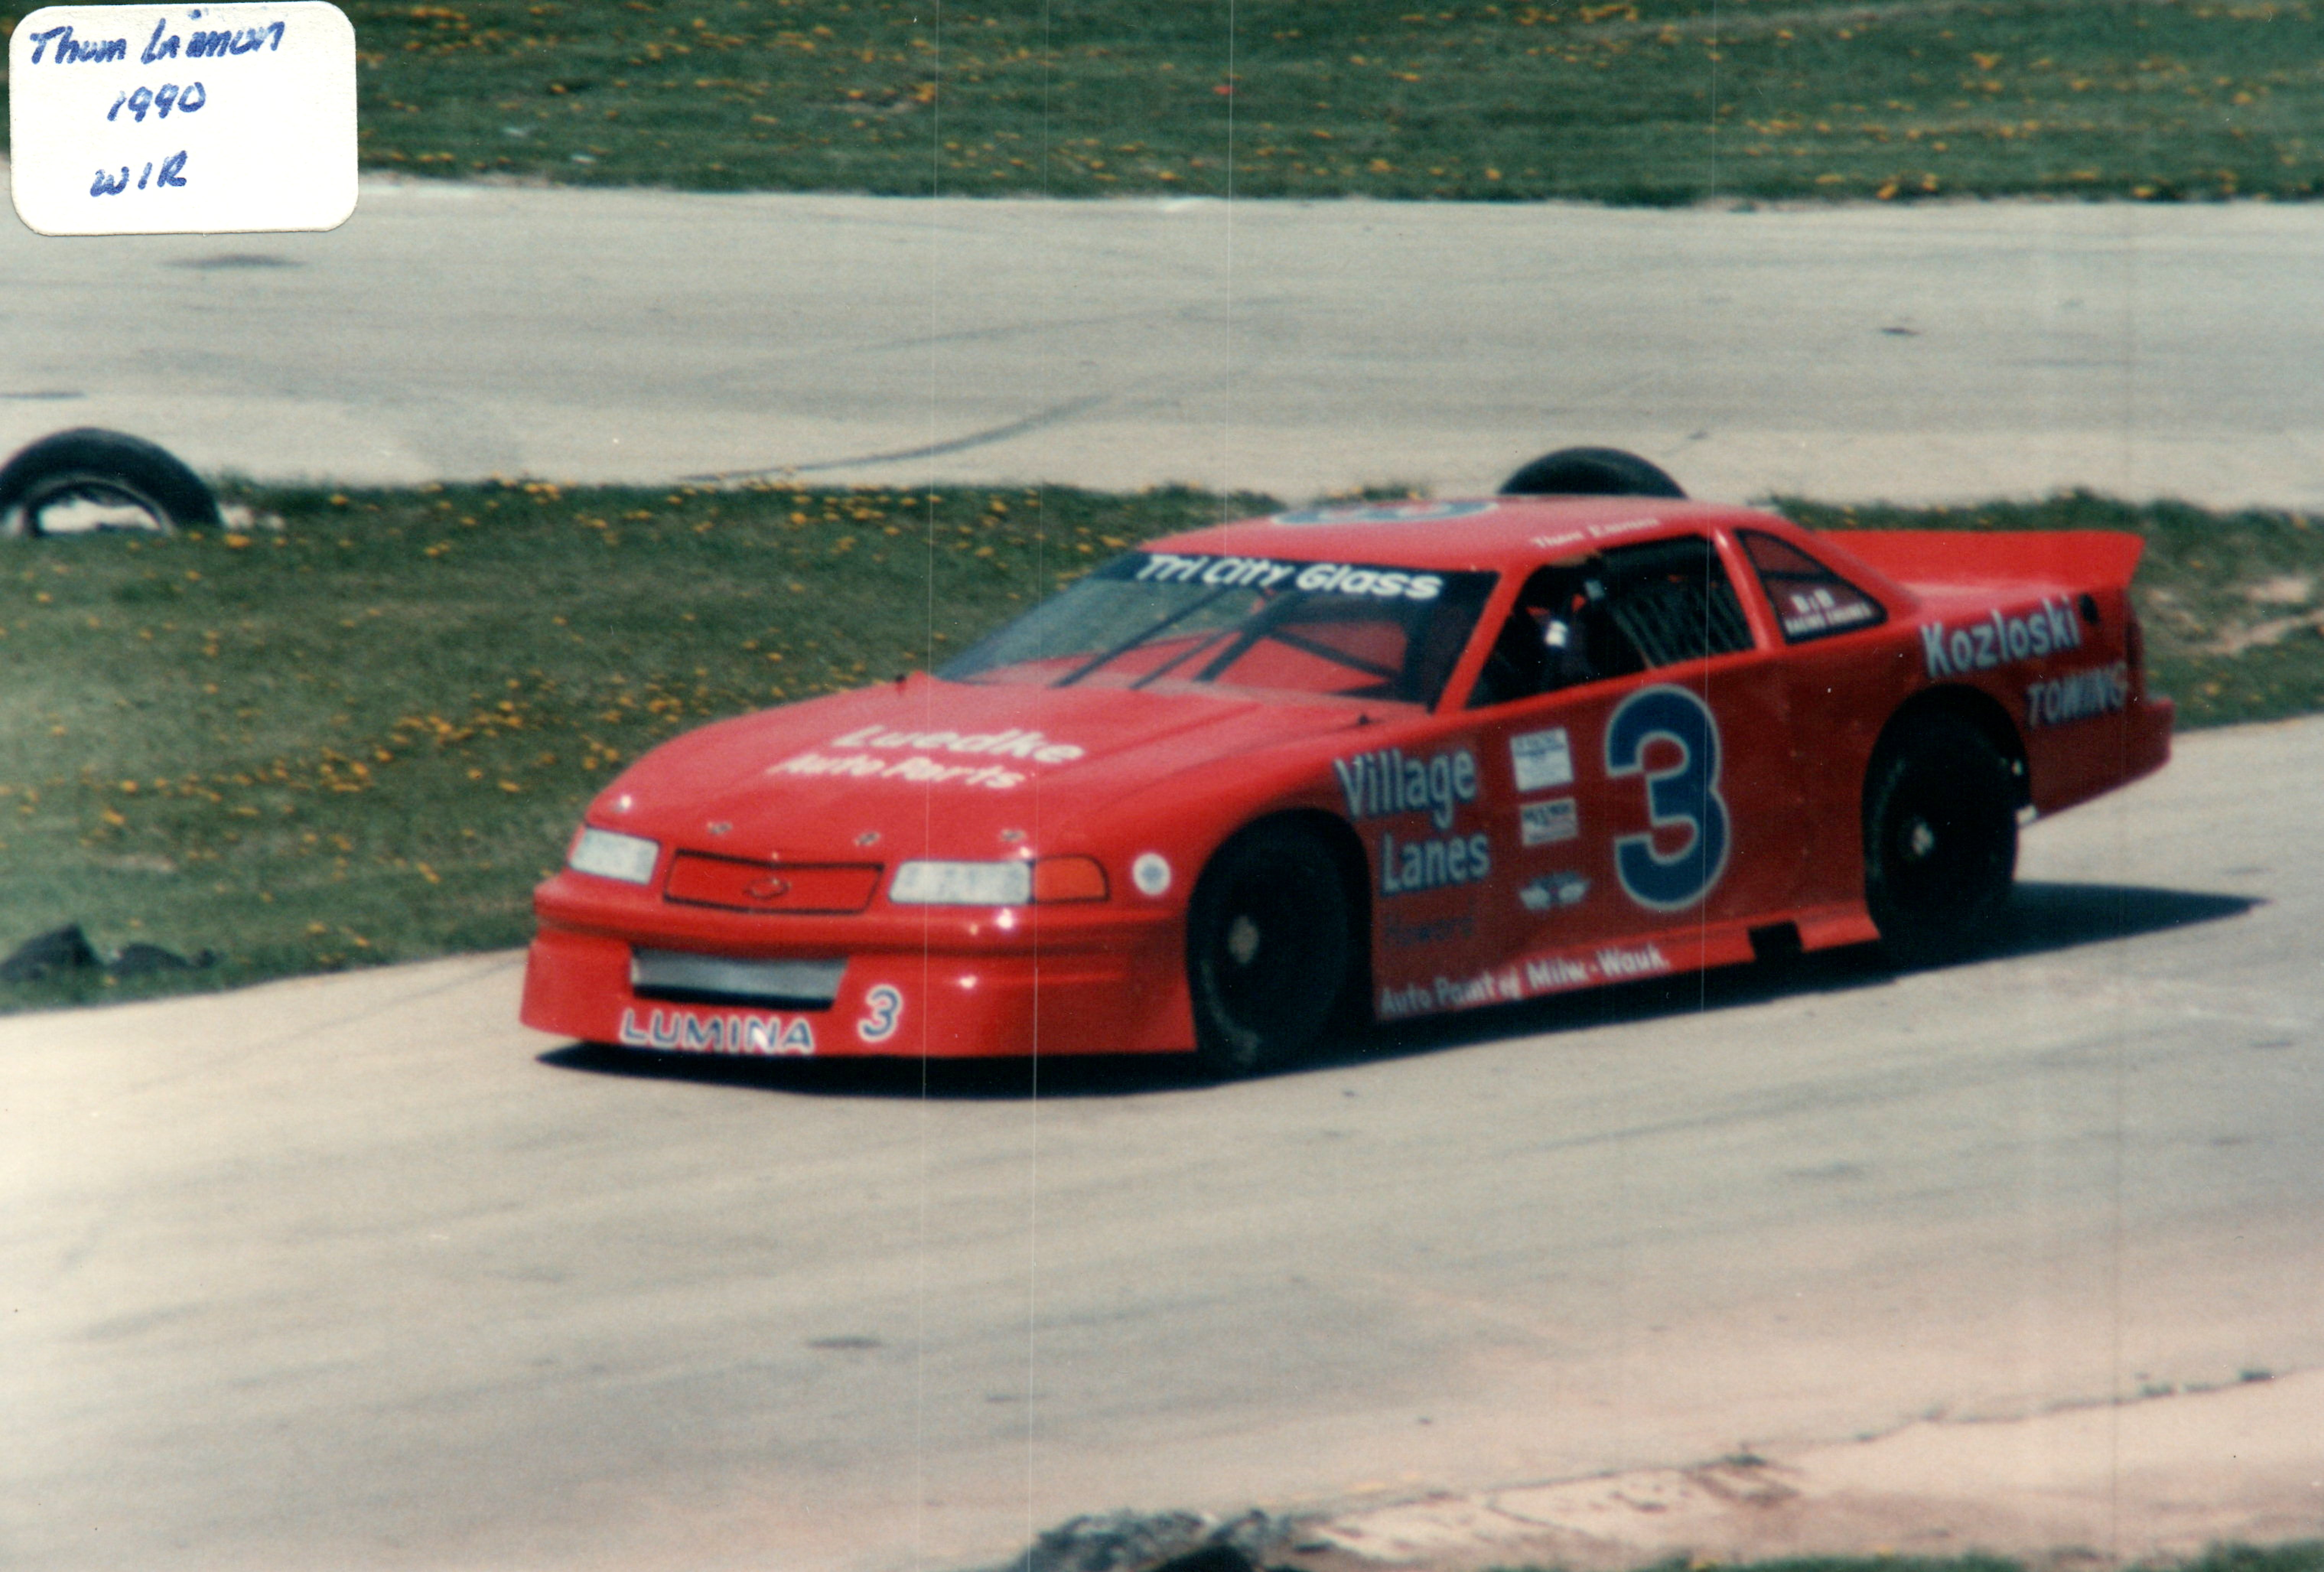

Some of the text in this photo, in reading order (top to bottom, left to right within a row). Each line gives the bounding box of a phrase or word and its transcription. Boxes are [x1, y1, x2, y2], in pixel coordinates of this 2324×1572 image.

[107, 81, 207, 122] 1990
[1135, 554, 1444, 601] Tri City Glass
[1920, 594, 2080, 679] Kozloski
[765, 752, 1026, 788] Auto Parts
[832, 724, 1085, 763] Luedke
[1333, 747, 1477, 830] Village
[1605, 683, 1732, 911] 3
[1380, 832, 1492, 897] Lanes
[618, 982, 903, 1055] LUMINA 3
[1380, 984, 1432, 1015] Auto
